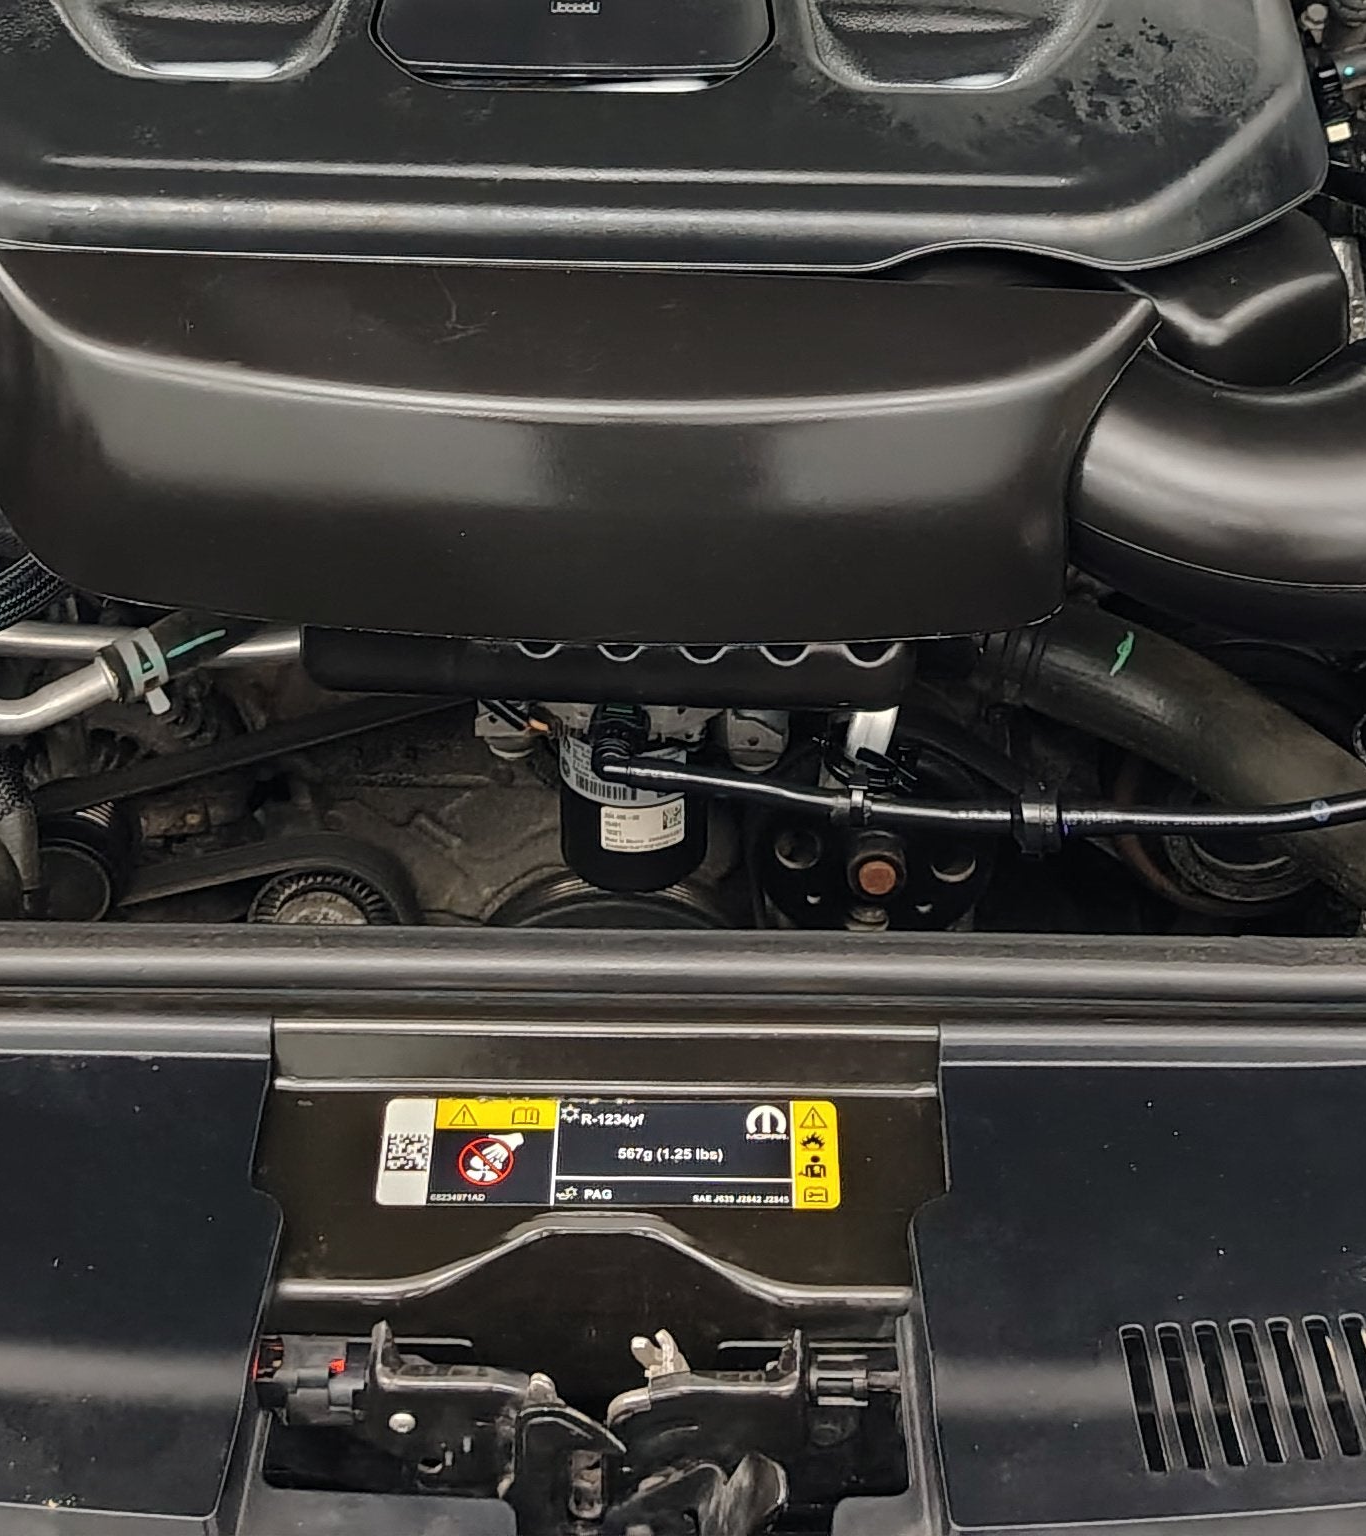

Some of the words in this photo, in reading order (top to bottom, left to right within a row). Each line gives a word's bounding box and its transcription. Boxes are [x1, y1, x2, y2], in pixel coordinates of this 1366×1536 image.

[580, 1113, 645, 1128] R-1234yf
[617, 1147, 653, 1162] 567g
[656, 1148, 692, 1163] (1.25
[695, 1148, 723, 1163] lbs)
[583, 1188, 613, 1200] PAG
[692, 1194, 712, 1203] SAE
